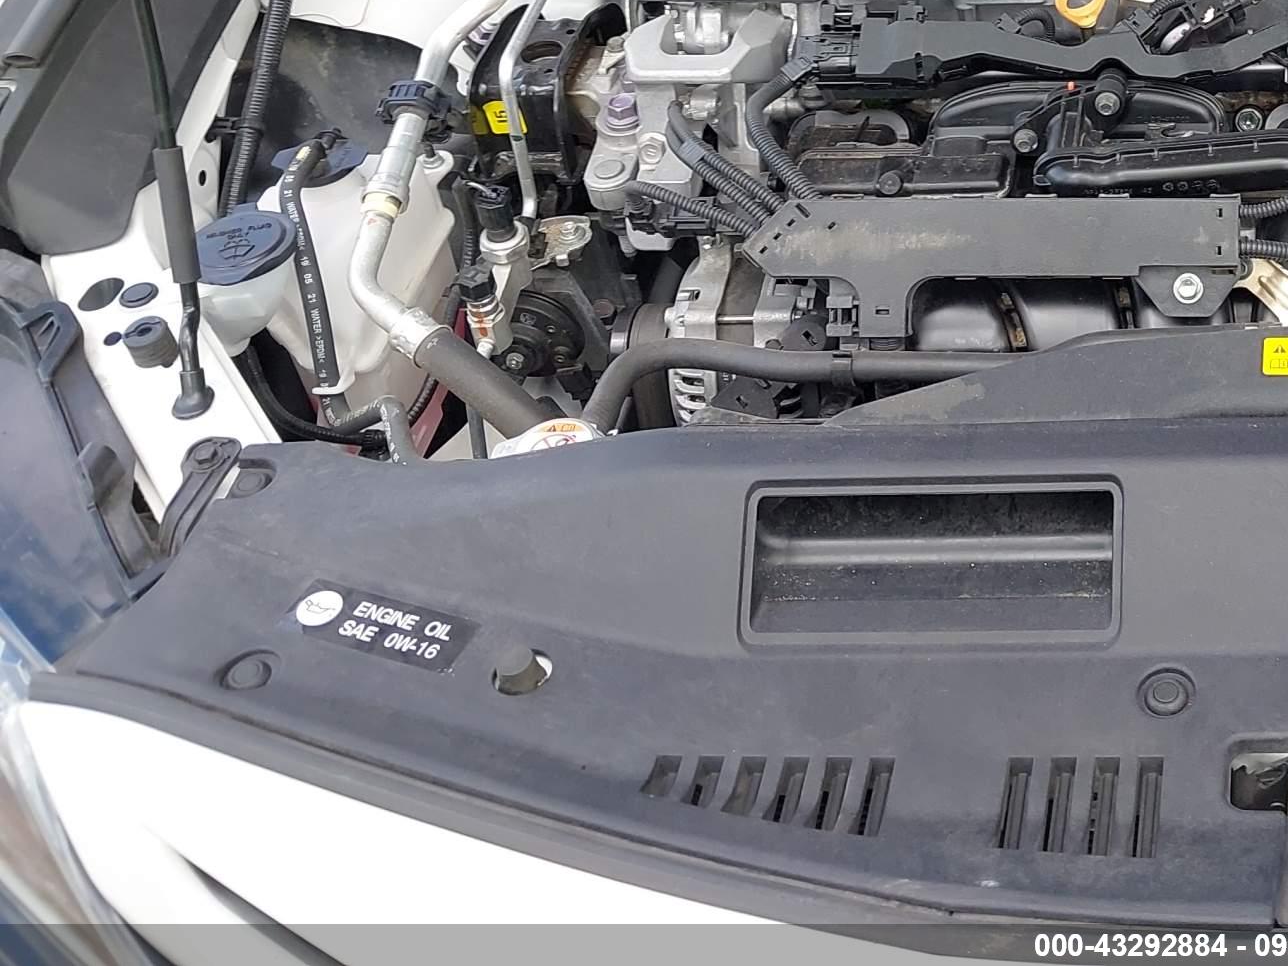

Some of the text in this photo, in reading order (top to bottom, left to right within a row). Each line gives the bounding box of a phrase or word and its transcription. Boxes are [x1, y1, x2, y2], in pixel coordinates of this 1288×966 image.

[306, 293, 317, 303] 21
[309, 308, 323, 334] WATER
[352, 601, 453, 642] ENGINE OIL
[338, 619, 441, 660] SAE 0W-16
